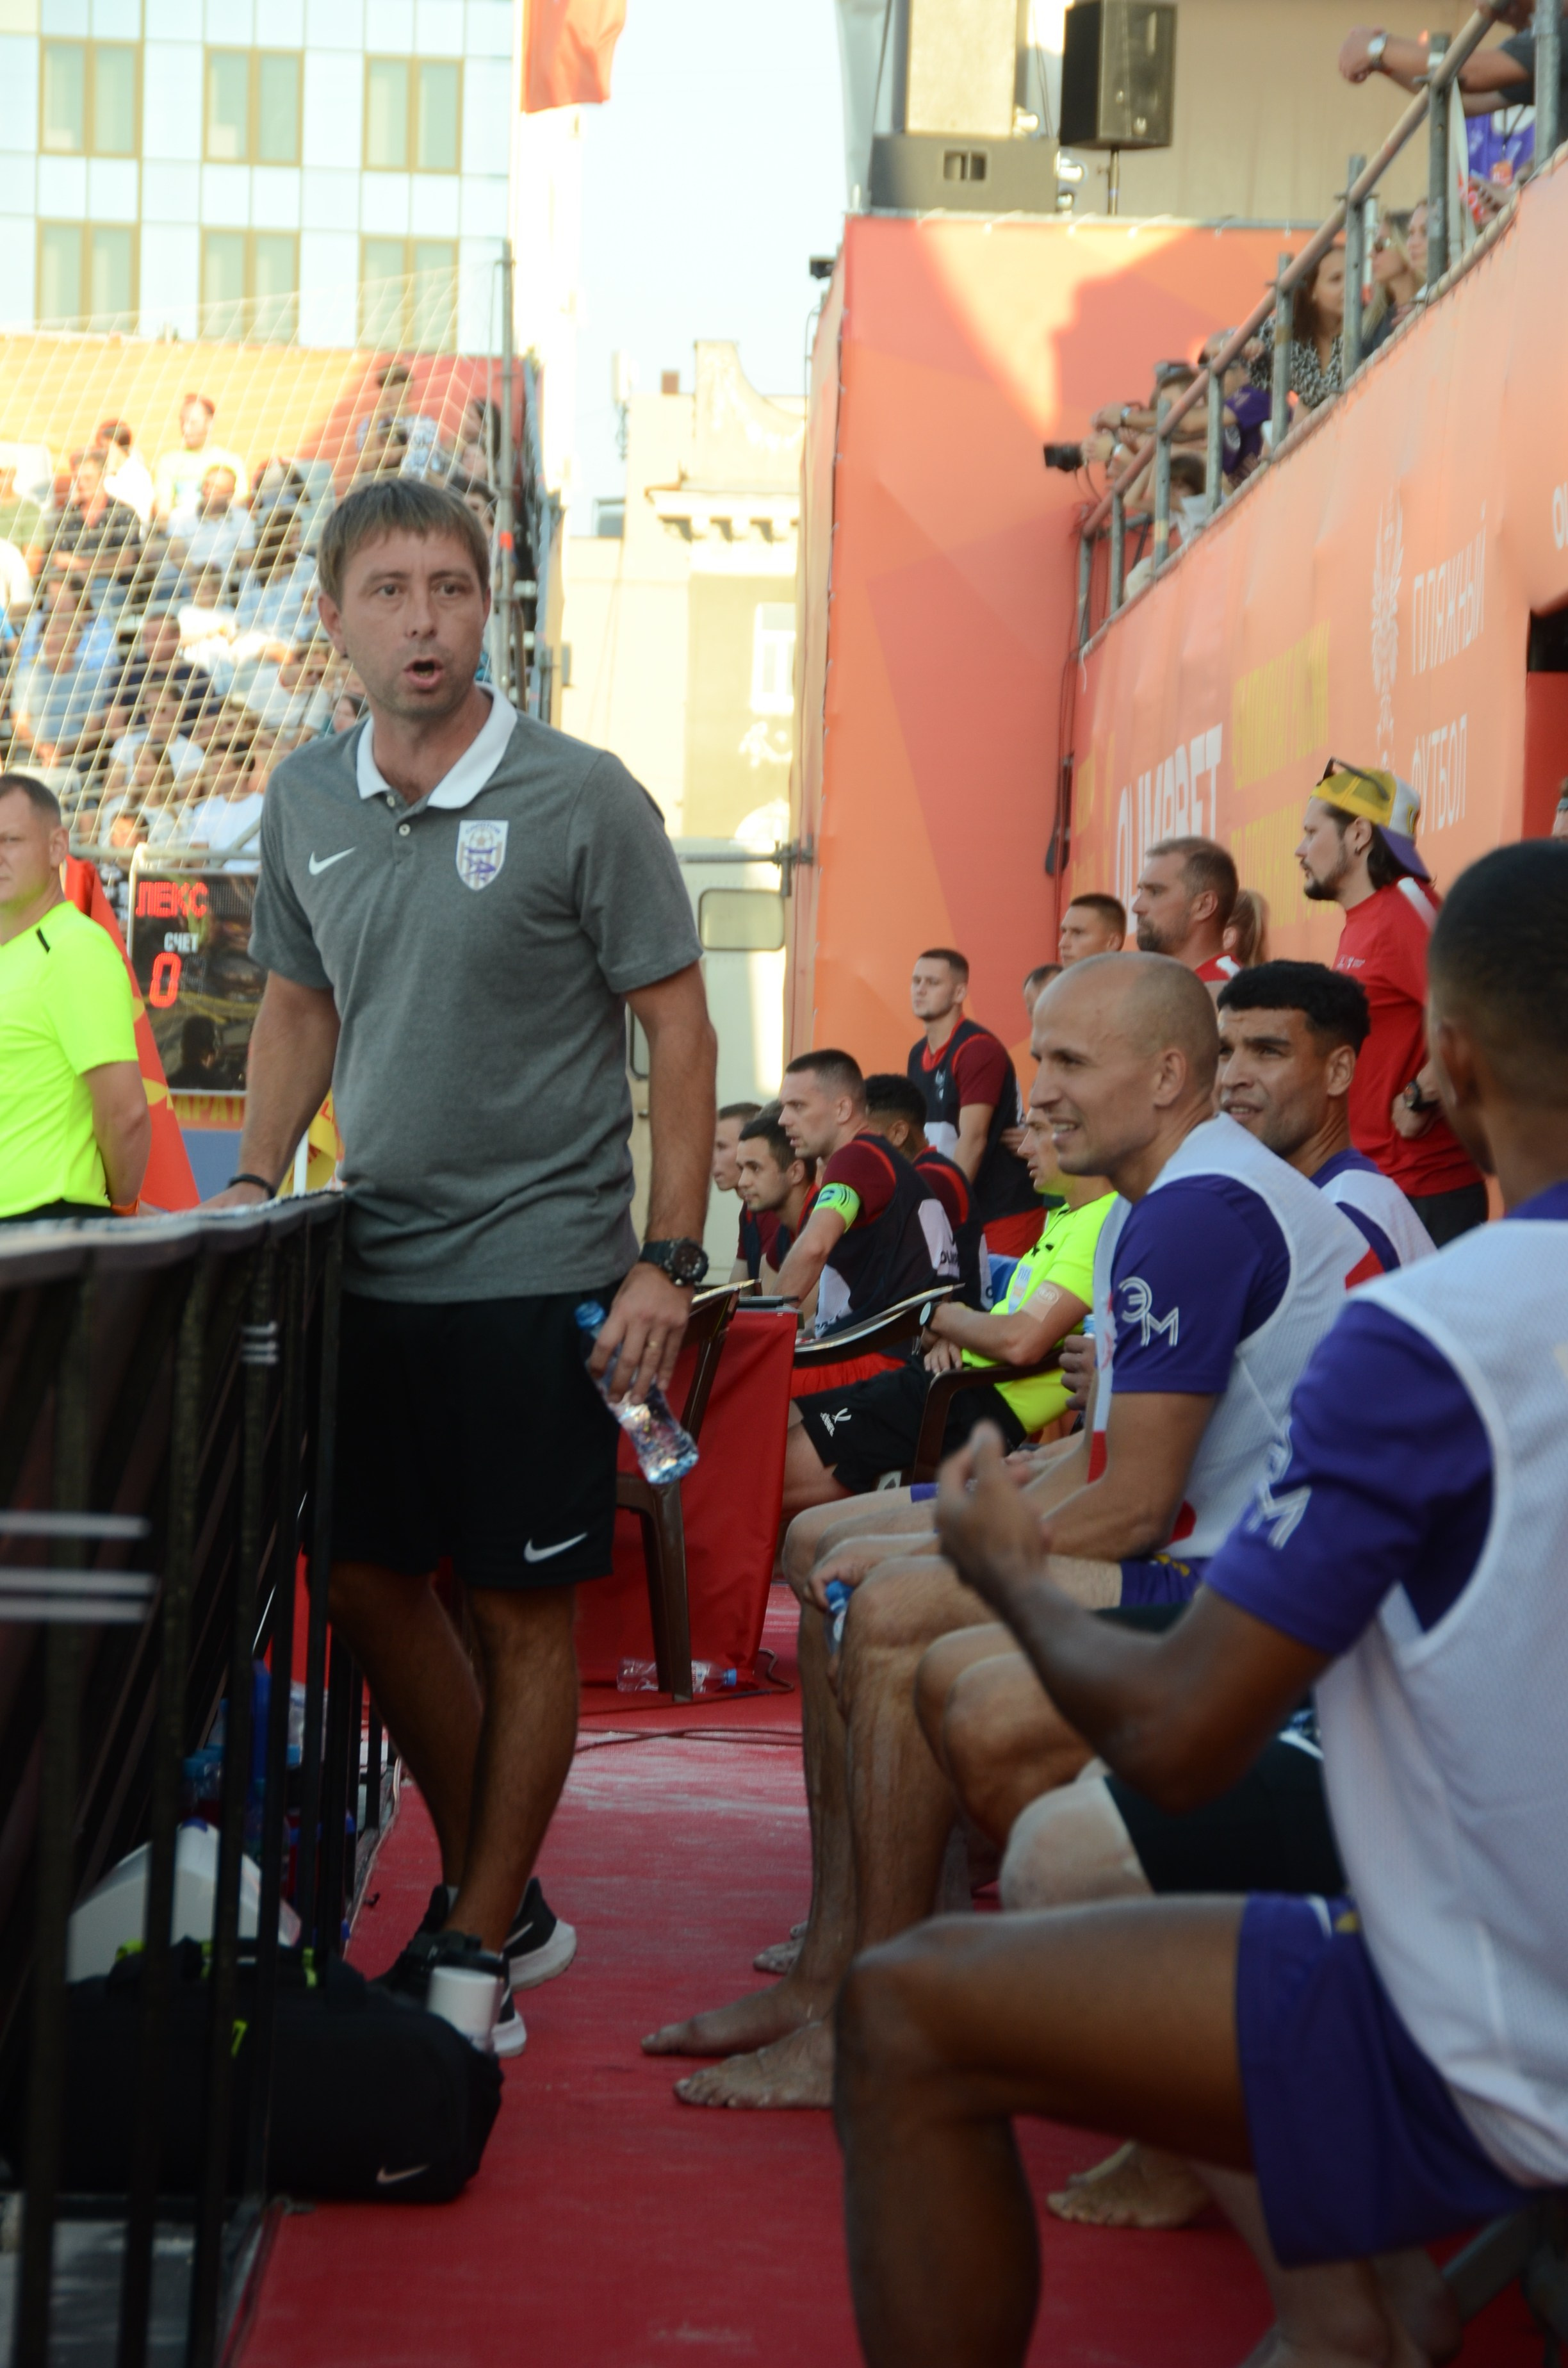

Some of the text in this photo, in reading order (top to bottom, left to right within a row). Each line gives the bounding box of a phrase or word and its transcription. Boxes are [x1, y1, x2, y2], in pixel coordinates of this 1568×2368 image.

[1412, 498, 1487, 676] ПЛЯЖНЫЙ
[1411, 712, 1467, 837] ФУТБОЛ
[135, 881, 208, 917] ЛЕКС
[163, 931, 199, 953] СЧЕТ
[149, 951, 182, 1008] 0
